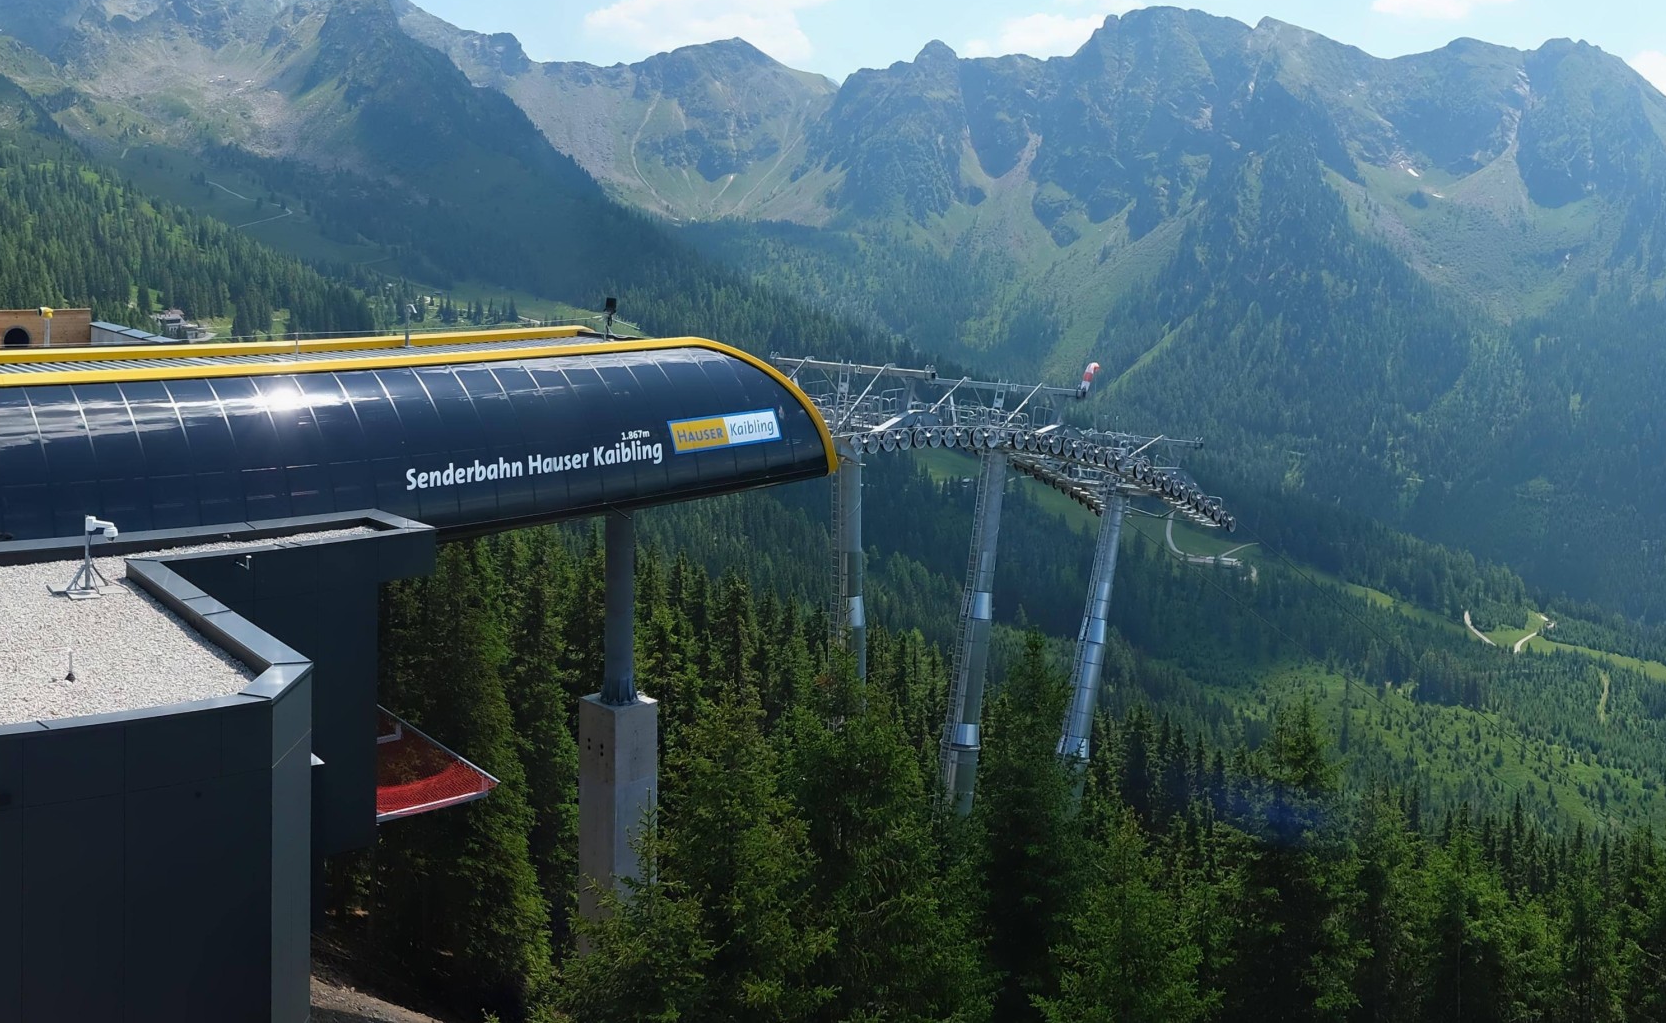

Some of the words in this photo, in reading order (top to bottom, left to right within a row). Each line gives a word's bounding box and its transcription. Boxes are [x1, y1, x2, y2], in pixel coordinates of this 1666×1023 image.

[621, 429, 650, 441] 1.867m
[676, 427, 724, 443] HAUSER
[729, 418, 775, 437] Kaibling
[406, 458, 523, 491] Senderbahn
[528, 450, 590, 475] Hauser
[593, 440, 663, 466] Kaibling
